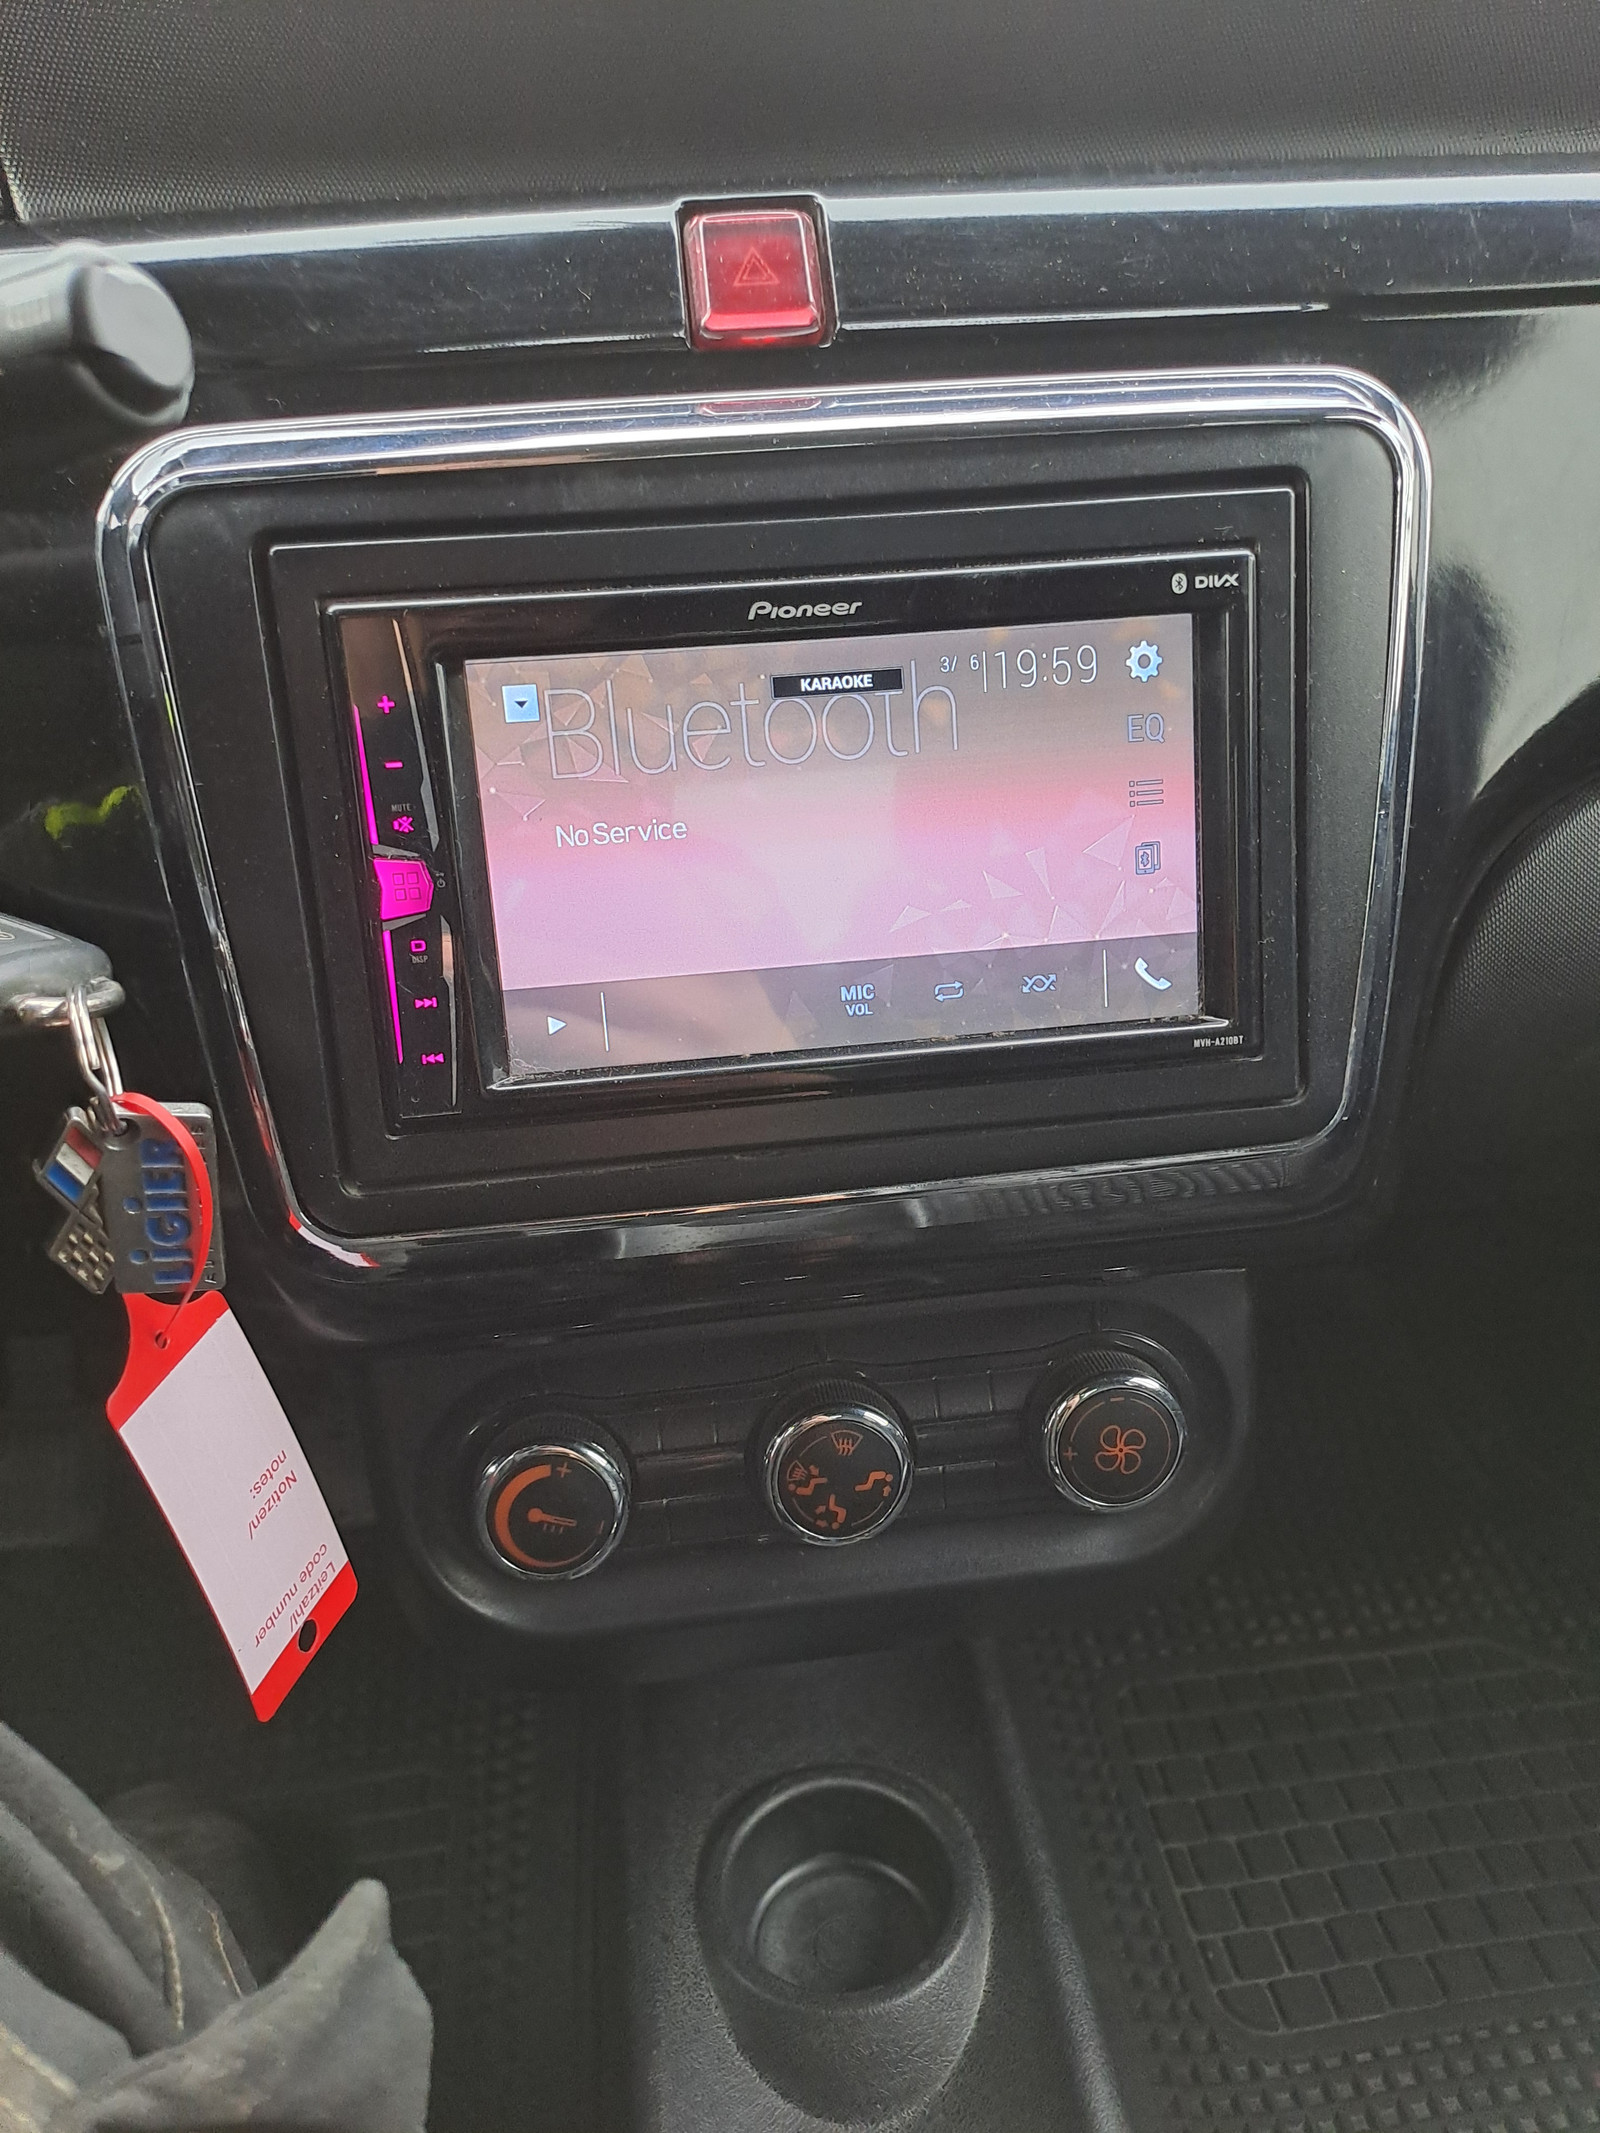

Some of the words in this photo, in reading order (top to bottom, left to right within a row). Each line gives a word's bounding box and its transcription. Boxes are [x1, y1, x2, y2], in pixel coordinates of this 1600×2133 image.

[748, 601, 862, 620] Pioneer
[995, 644, 1098, 688] 19:59
[800, 673, 873, 692] KARAOKE
[543, 659, 958, 779] Bluetooth
[1127, 713, 1165, 743] EQ
[391, 803, 411, 812] MUTE
[555, 824, 590, 848] No
[592, 819, 688, 845] Service
[411, 955, 429, 964] DISP
[840, 983, 875, 1002] MIC
[845, 1002, 874, 1017] VOL
[1193, 1035, 1244, 1048] MVH-A210BT
[249, 1450, 287, 1499] notes:
[248, 1470, 298, 1540] Notizen/
[300, 1544, 328, 1583] code
[289, 1561, 336, 1633] Leitzahl/
[254, 1583, 298, 1648] number
